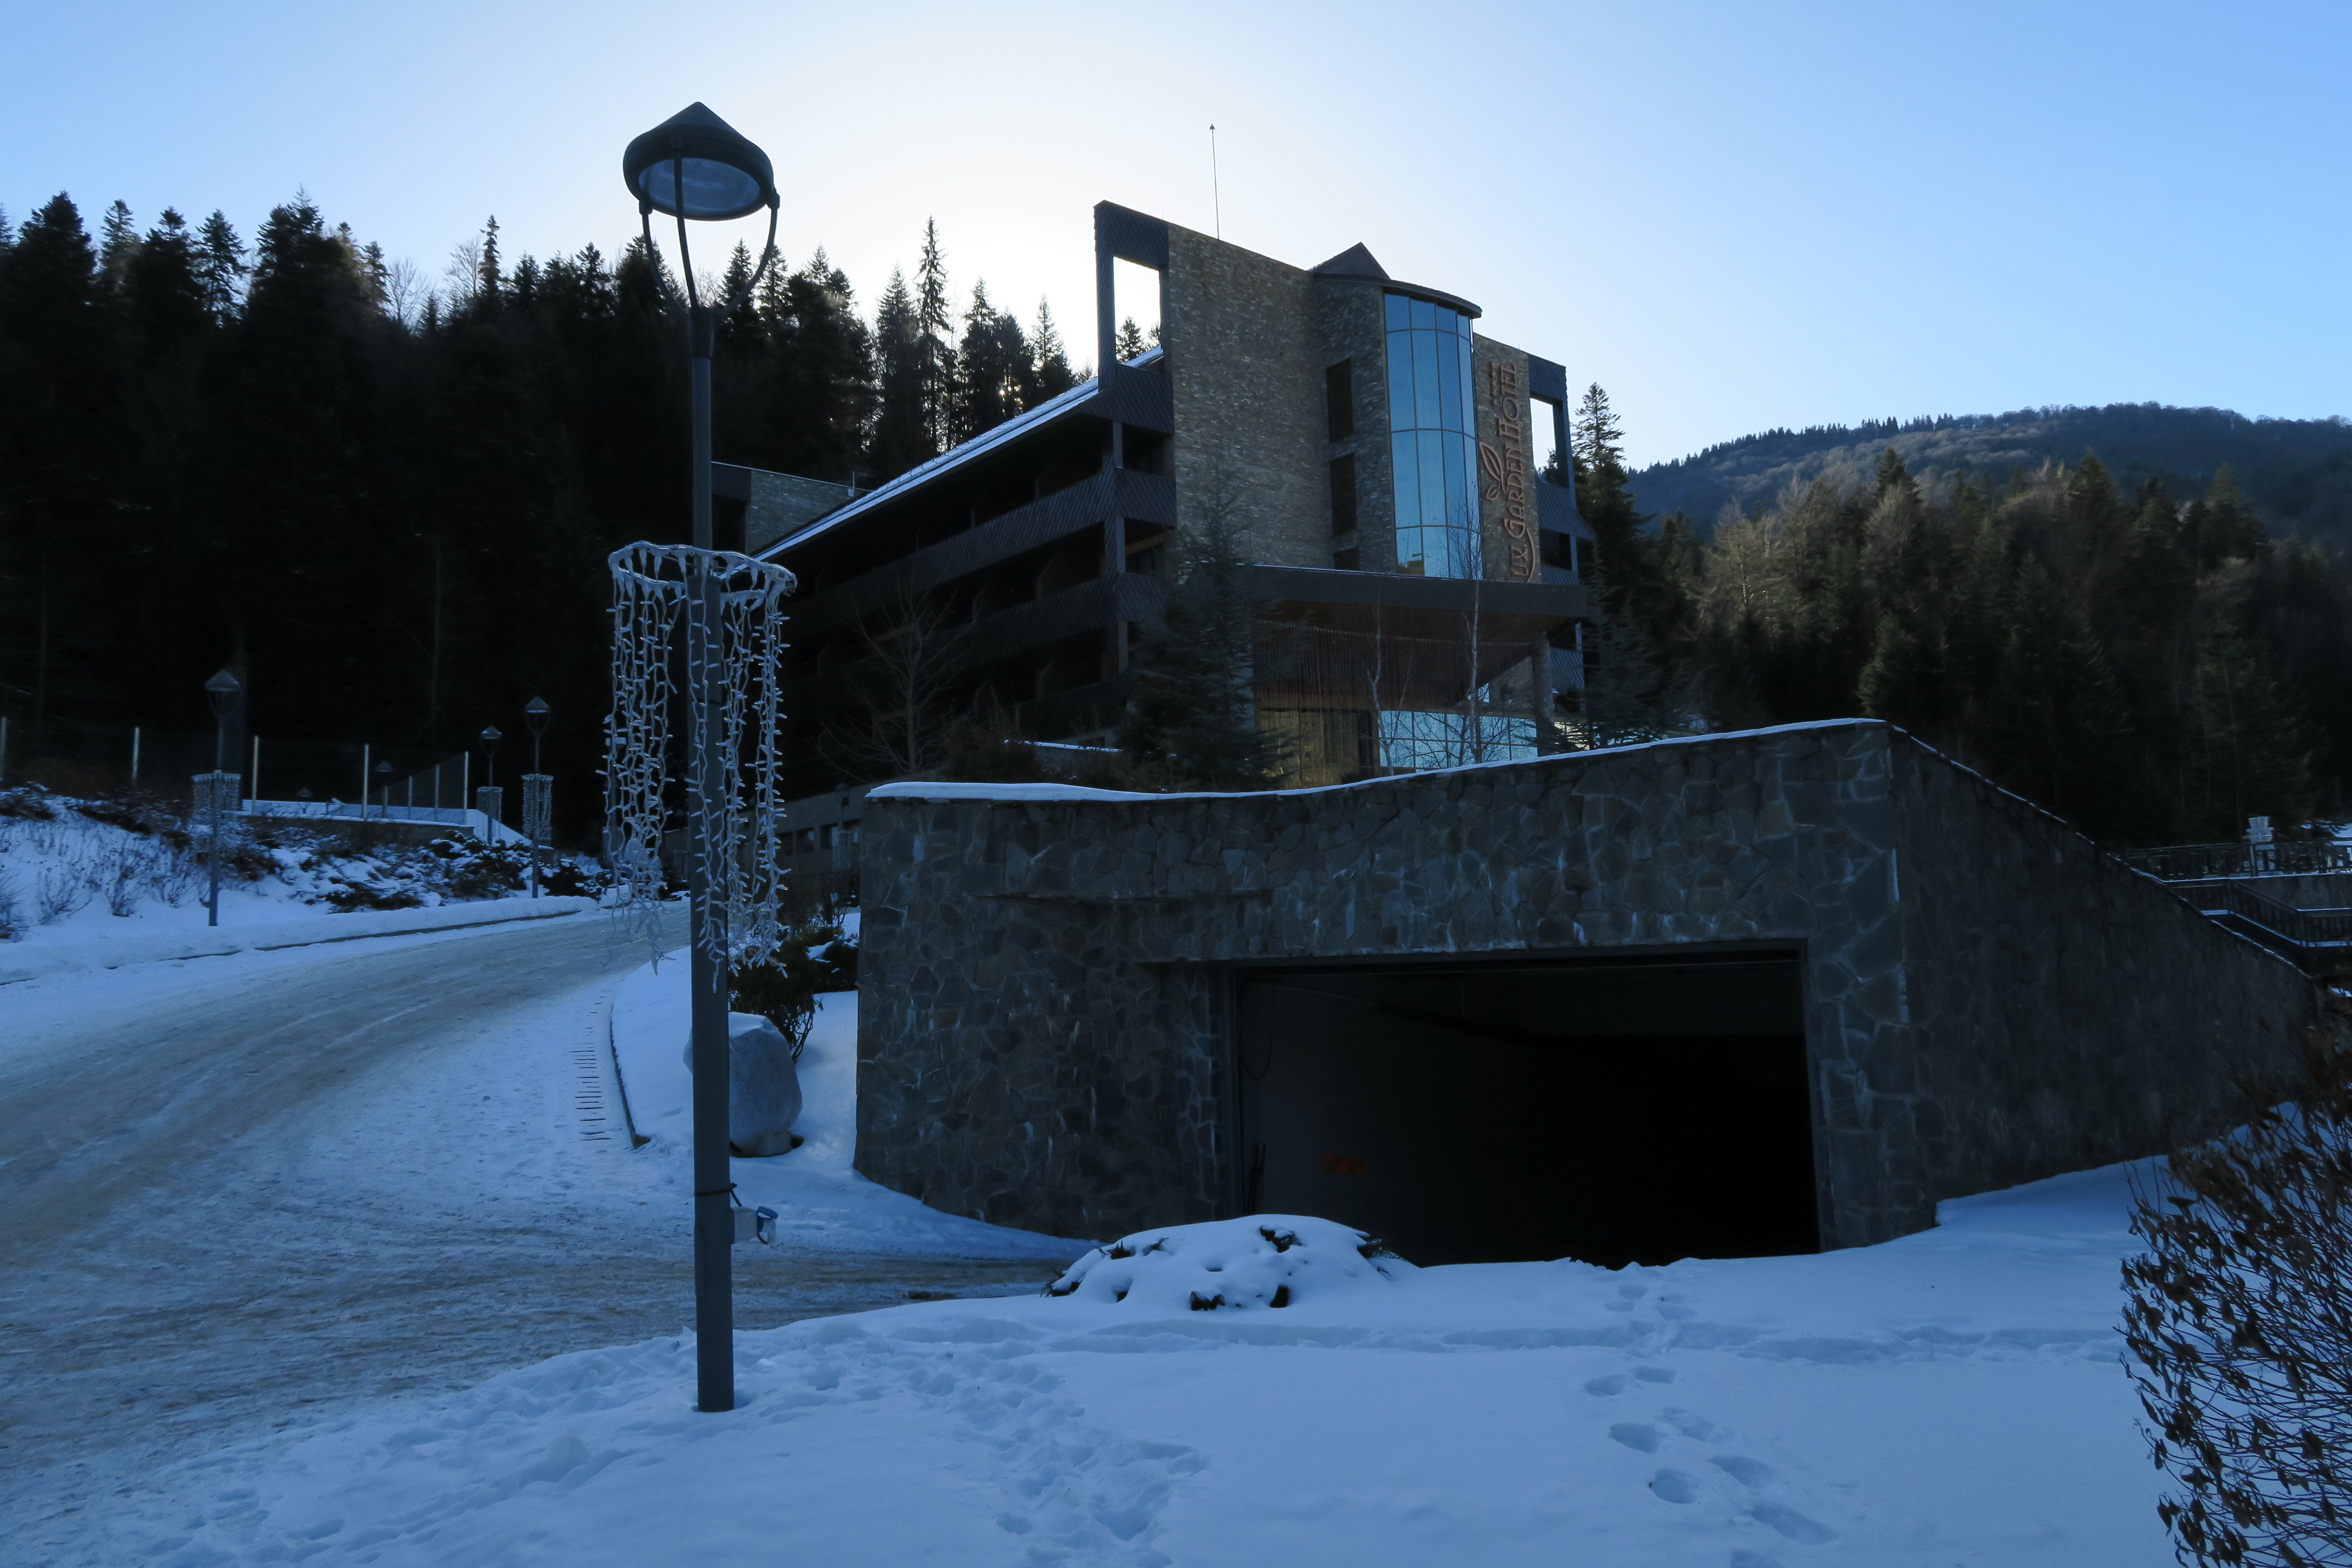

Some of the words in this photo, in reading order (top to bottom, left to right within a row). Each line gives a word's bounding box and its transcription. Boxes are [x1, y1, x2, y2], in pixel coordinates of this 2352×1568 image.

[1499, 364, 1522, 442] HOTEL
[1504, 443, 1526, 539] GARDEN
[1511, 544, 1529, 579] UX
